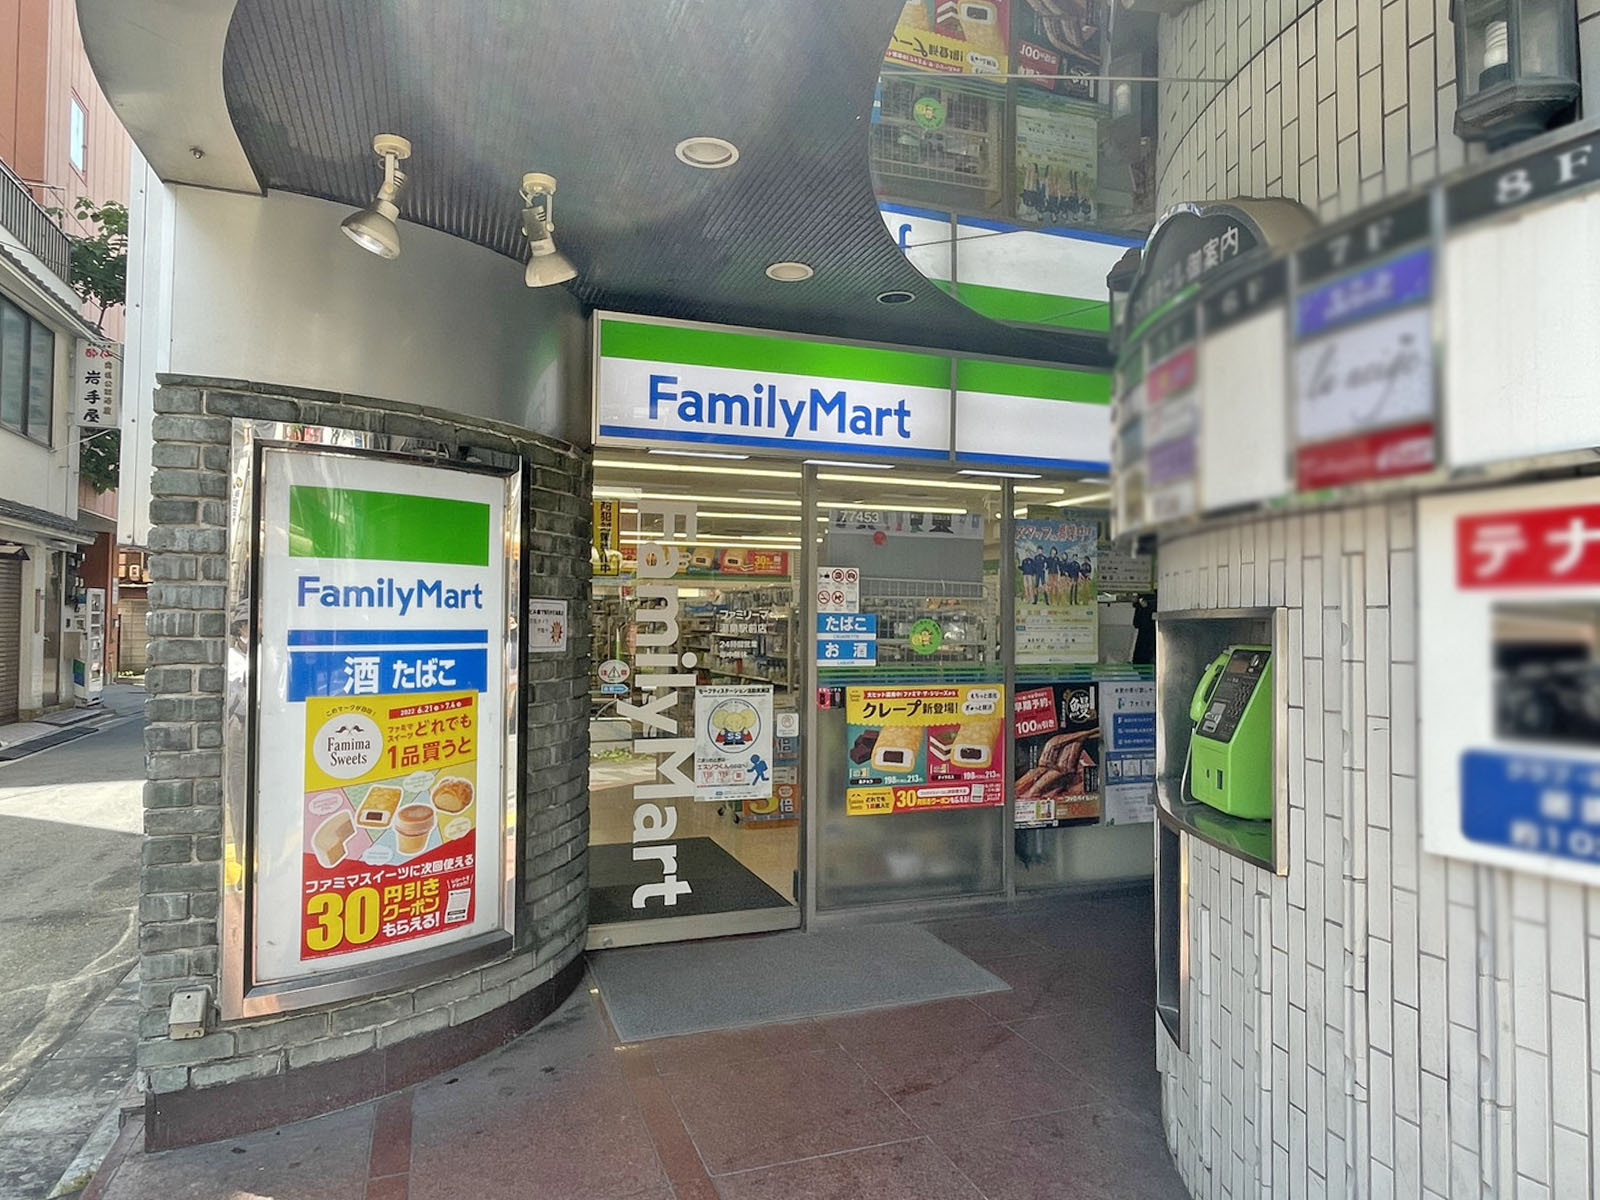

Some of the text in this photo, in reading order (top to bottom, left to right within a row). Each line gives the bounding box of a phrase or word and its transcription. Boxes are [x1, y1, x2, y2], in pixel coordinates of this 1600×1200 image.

[83, 370, 101, 423] 岩手屋
[649, 374, 911, 438] FamilyMart
[298, 576, 483, 616] FamilyMart
[826, 616, 867, 631] たばこ
[344, 656, 457, 694] 酒 たばこ
[616, 501, 697, 909] FamilyMart
[415, 713, 472, 737] どれでも
[327, 737, 371, 752] Famima
[330, 751, 367, 767] Sweets
[387, 736, 472, 769] 1品買うと
[305, 853, 475, 894] ファミマスイーツに次回使える
[306, 878, 441, 952] 30 円引き
[383, 896, 440, 922] クーポン
[383, 911, 441, 938] もらえる!
